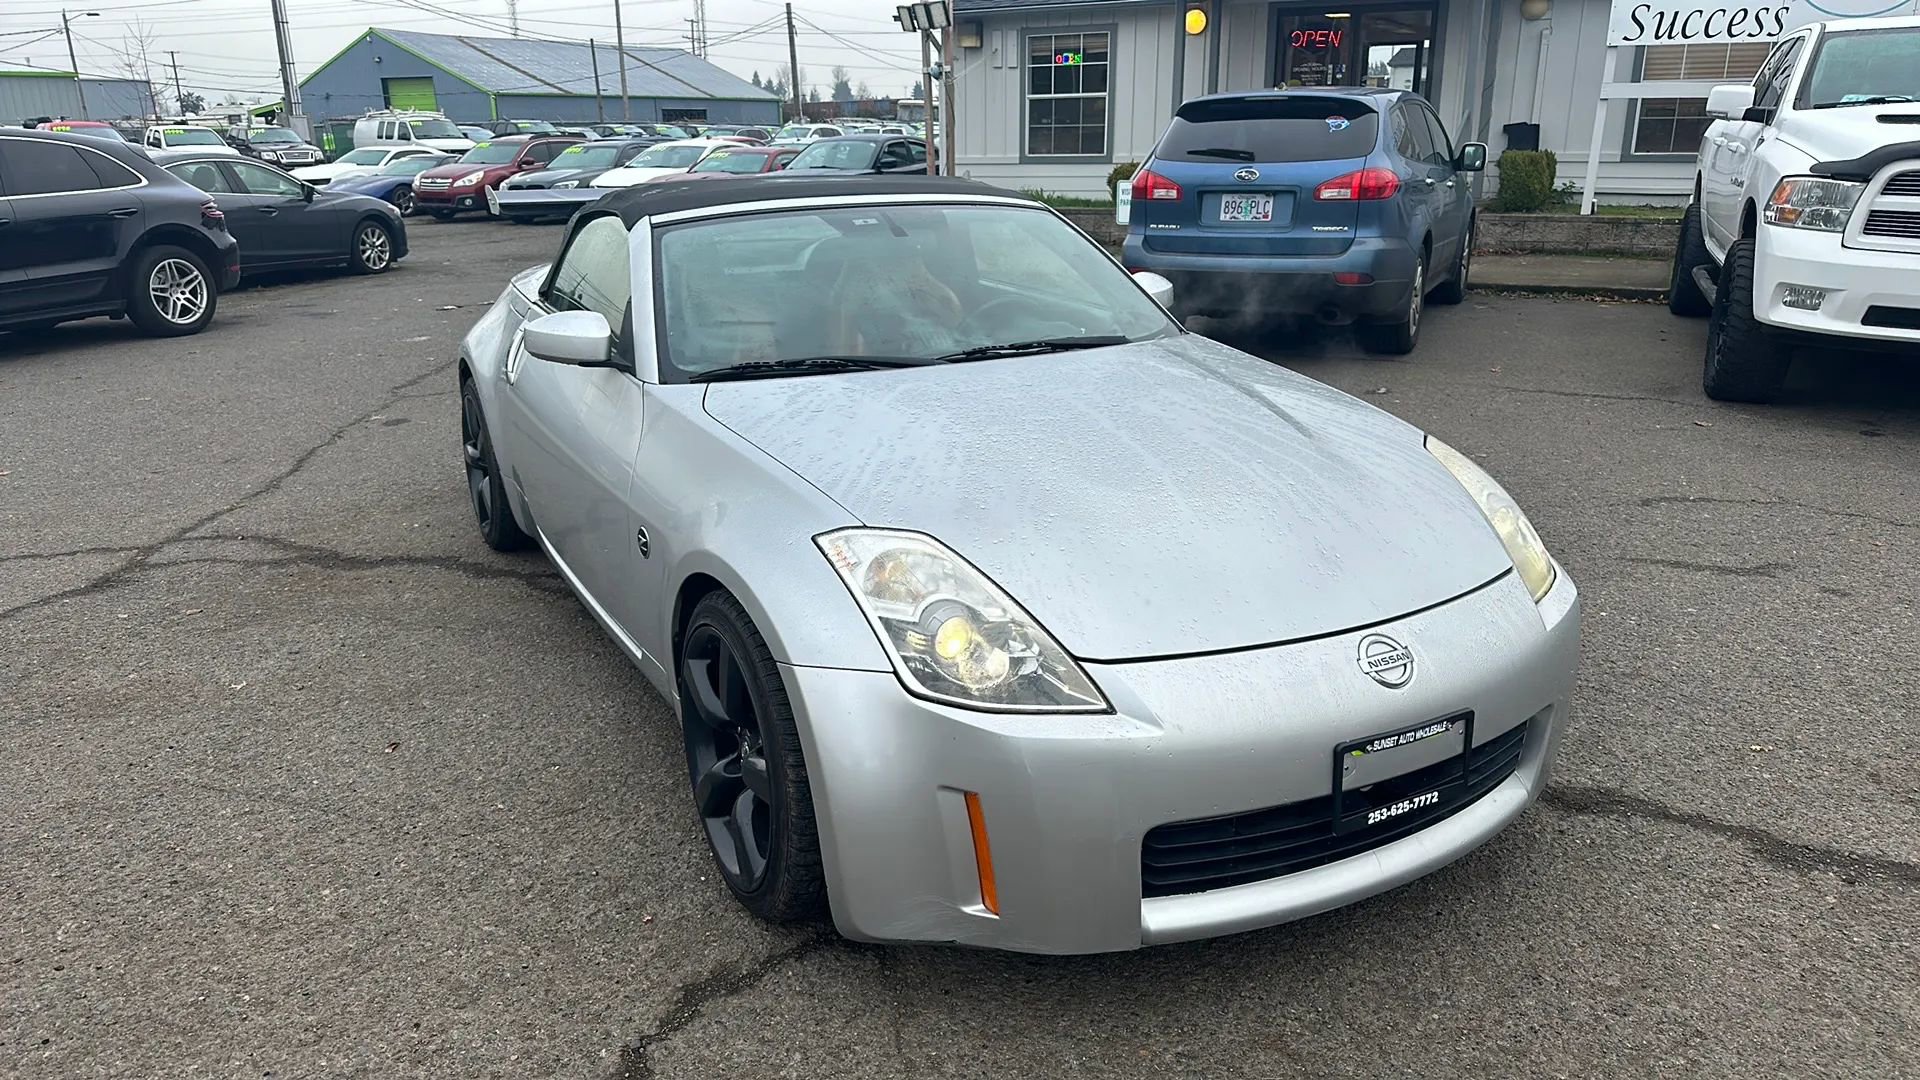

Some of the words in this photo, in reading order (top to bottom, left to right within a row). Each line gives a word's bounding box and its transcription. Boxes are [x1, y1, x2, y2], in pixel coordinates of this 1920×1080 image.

[1621, 3, 1790, 42] Success
[1291, 30, 1342, 48] OPEN
[1223, 200, 1243, 215] 896
[1249, 200, 1271, 215] PLC
[1367, 651, 1411, 669] NISSAN
[1372, 735, 1399, 751] SUNSET
[1398, 731, 1415, 746] AUTO
[1415, 721, 1448, 742] WHOLESALE
[1367, 791, 1440, 825] 253-625-7772
